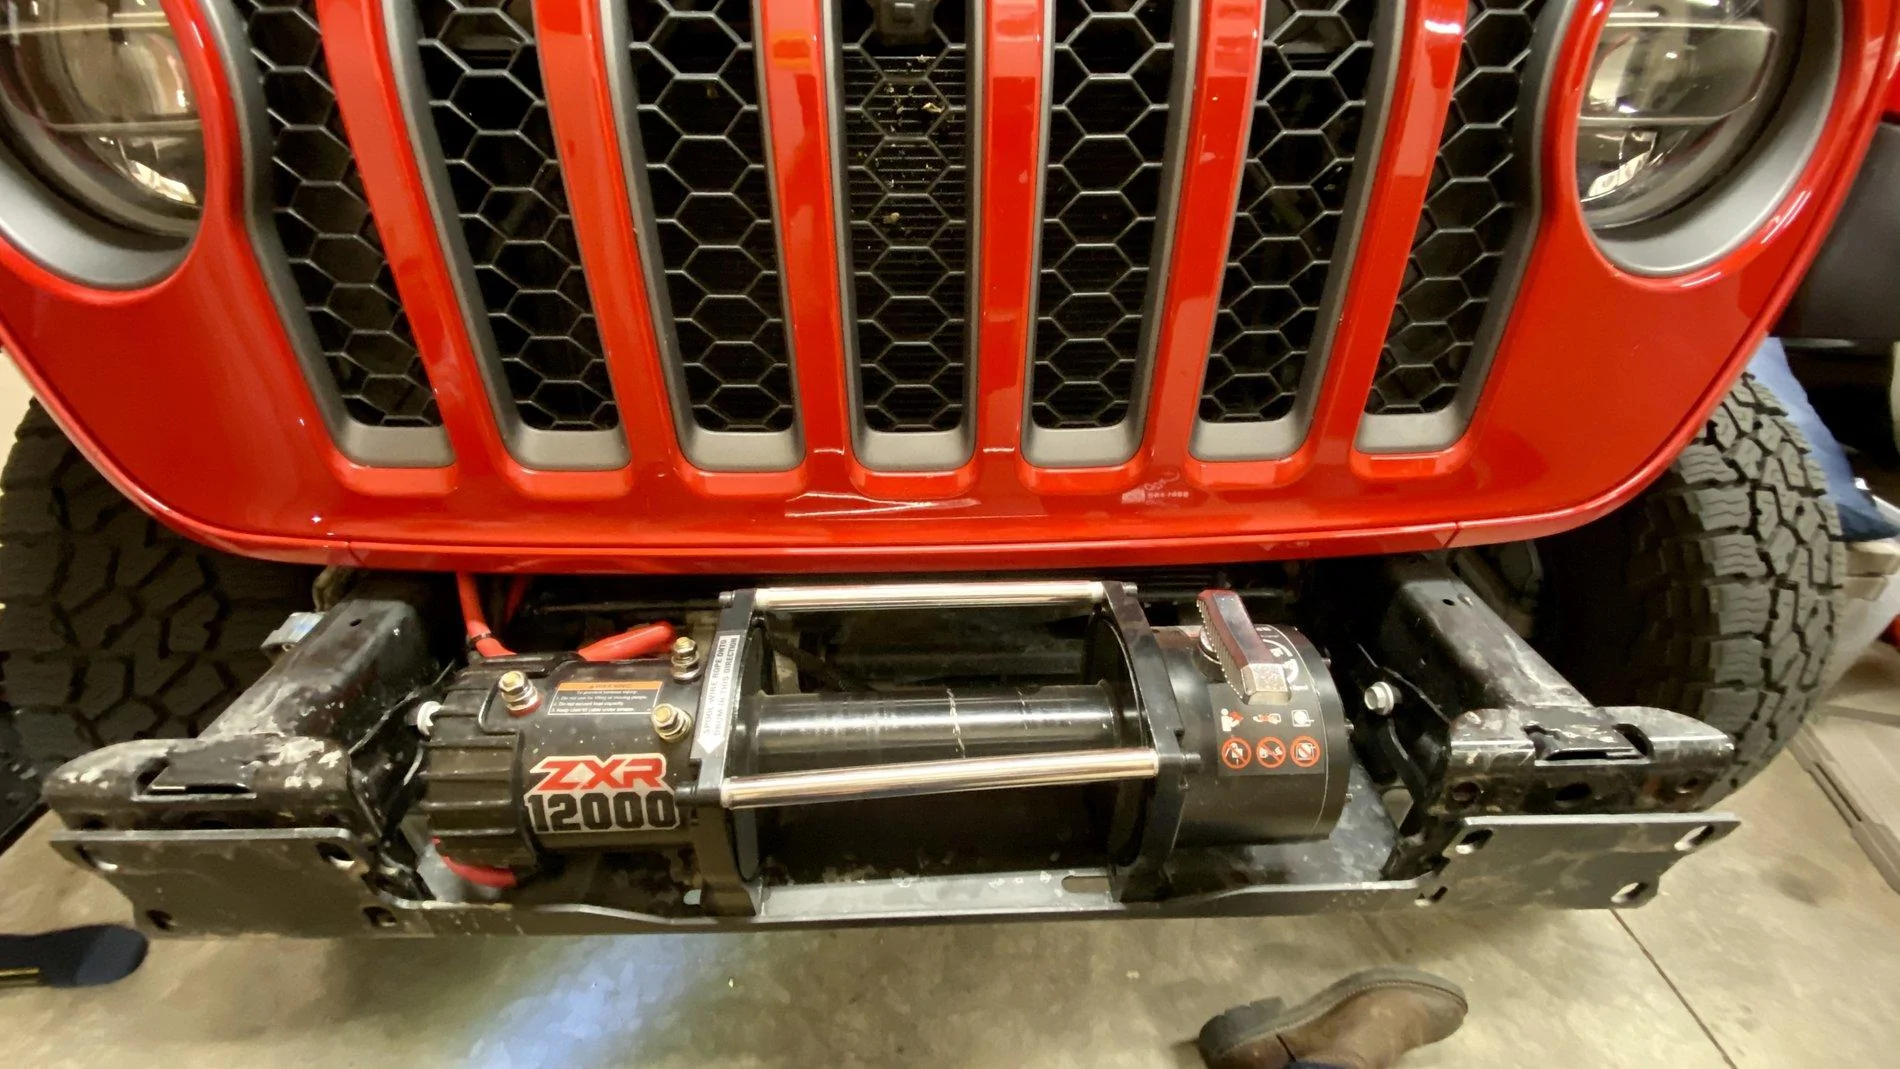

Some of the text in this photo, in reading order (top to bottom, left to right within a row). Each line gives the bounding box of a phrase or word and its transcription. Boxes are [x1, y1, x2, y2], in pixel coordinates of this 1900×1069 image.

[711, 658, 722, 678] ROPE
[717, 639, 728, 657] ONTO
[723, 637, 738, 673] DIRECTION
[532, 755, 664, 791] ZXR
[527, 790, 678, 833] 12000
